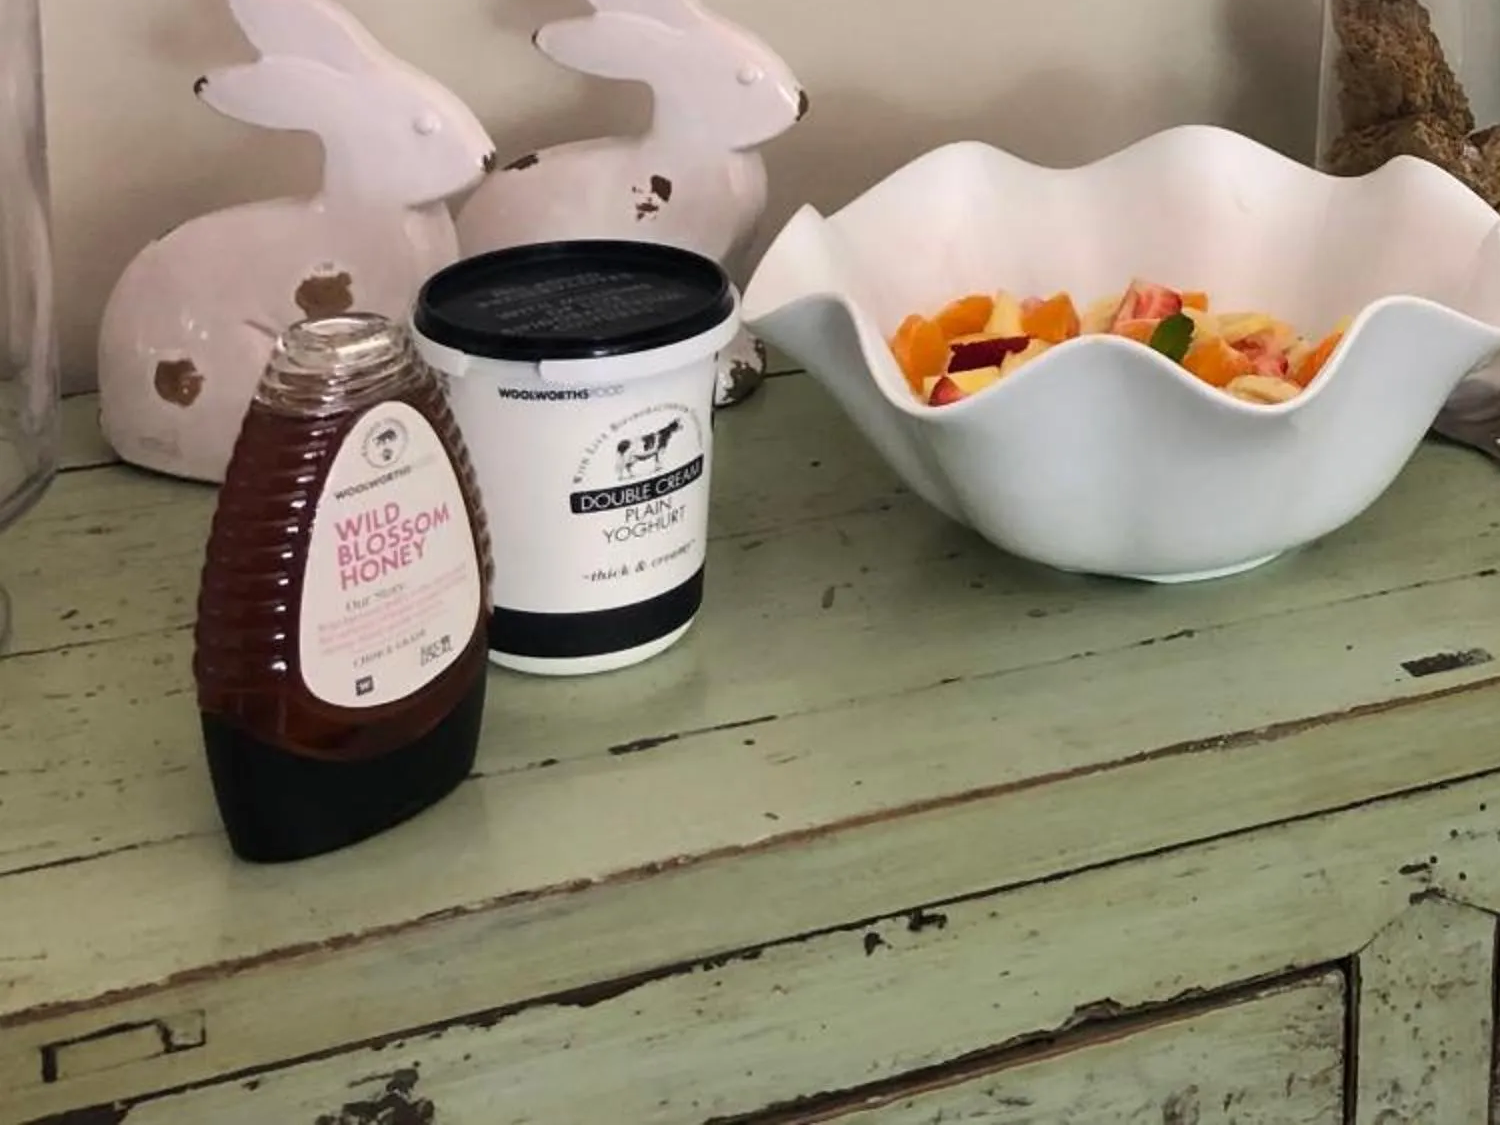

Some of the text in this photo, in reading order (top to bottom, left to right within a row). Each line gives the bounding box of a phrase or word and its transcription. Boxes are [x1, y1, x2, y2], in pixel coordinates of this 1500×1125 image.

[580, 461, 701, 511] DOUBLE CREAM
[335, 502, 400, 541] WILD
[602, 506, 687, 543] YOGHURT
[625, 496, 673, 523] PLAIN
[337, 502, 450, 567] BLOSSOM
[340, 537, 426, 591] HONEY
